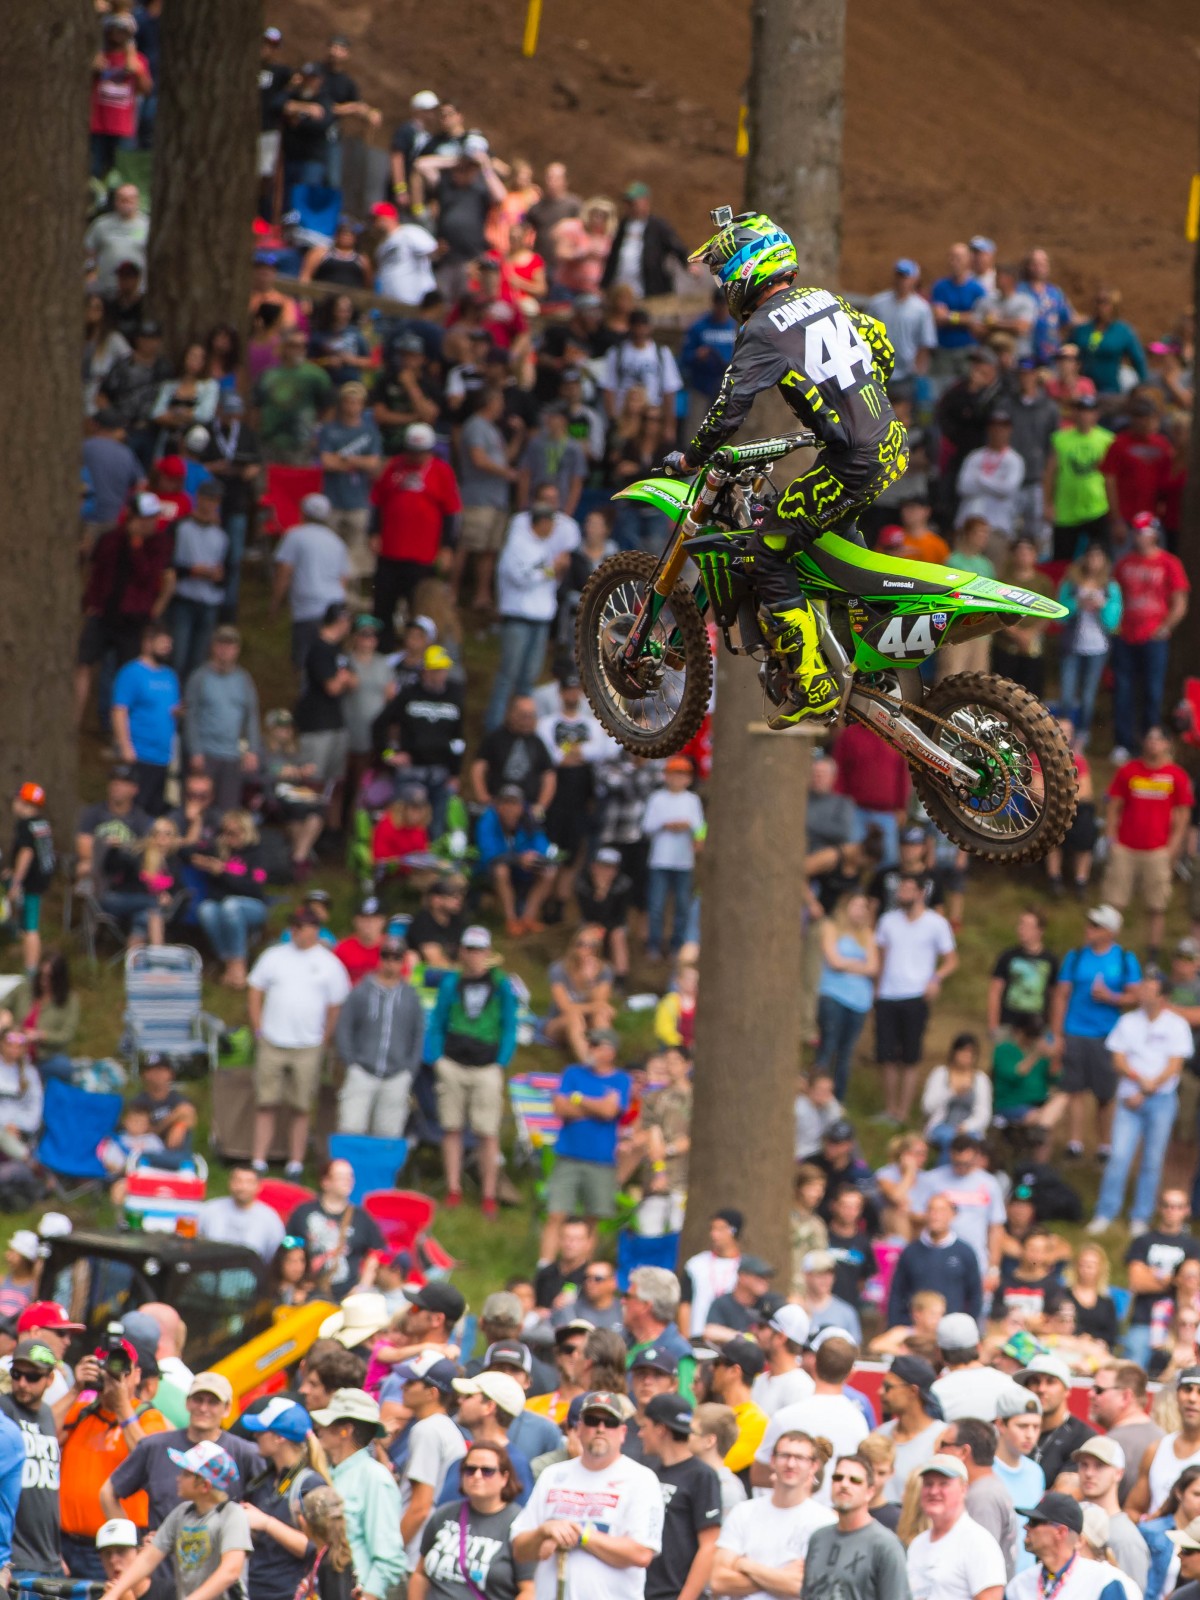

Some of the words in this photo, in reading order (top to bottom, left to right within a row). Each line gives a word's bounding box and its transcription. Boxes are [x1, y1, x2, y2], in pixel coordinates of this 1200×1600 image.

[742, 261, 754, 277] BELL
[805, 310, 874, 390] 44
[883, 580, 914, 589] Kawasaki
[877, 614, 936, 658] 44
